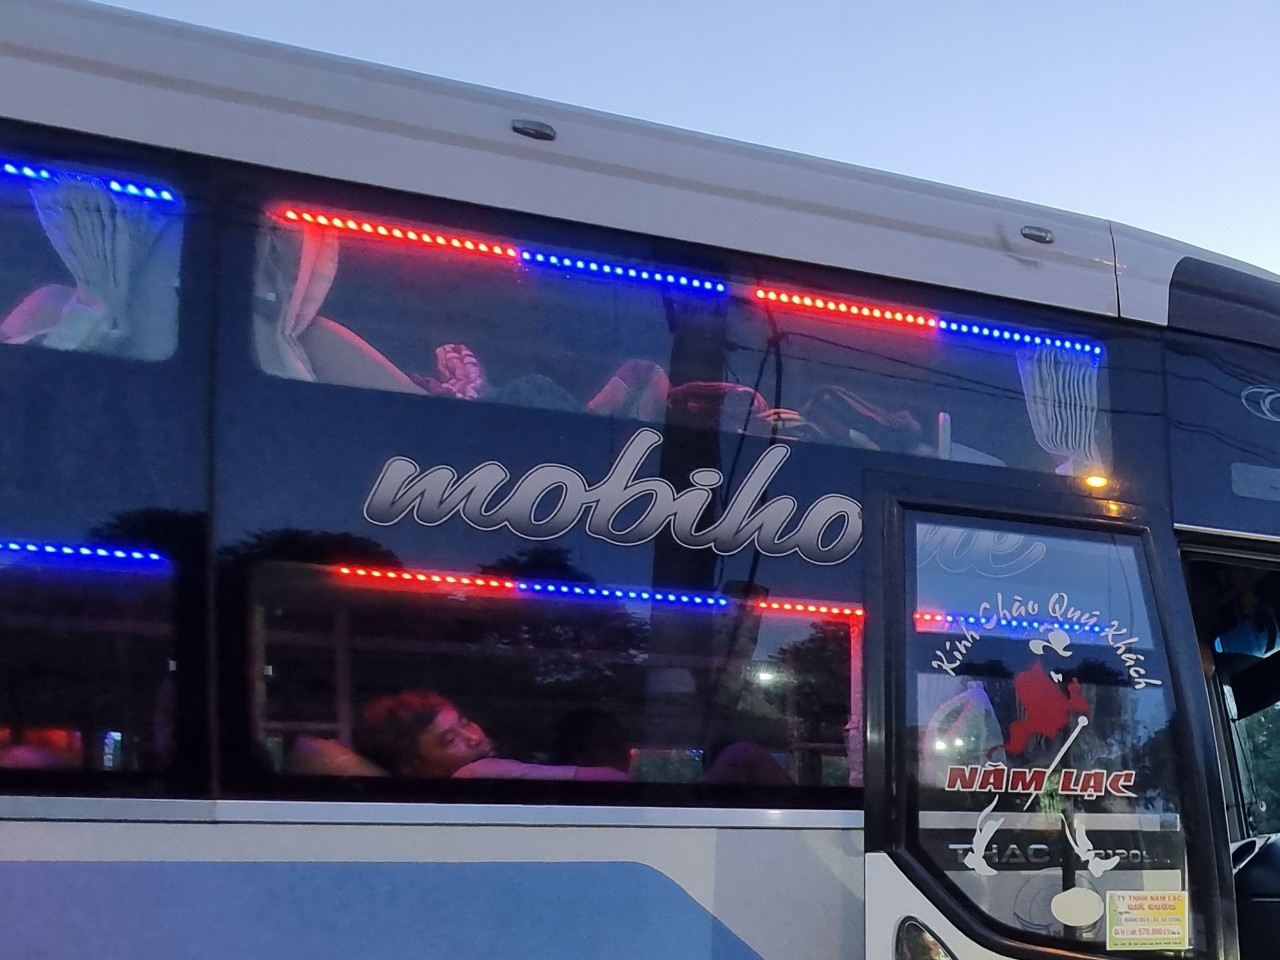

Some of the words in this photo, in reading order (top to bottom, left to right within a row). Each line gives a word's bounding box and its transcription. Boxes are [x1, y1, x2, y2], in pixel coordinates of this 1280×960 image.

[979, 592, 1039, 630] Chào
[945, 761, 1050, 794] NĂM
[1058, 768, 1138, 800] LẠC
